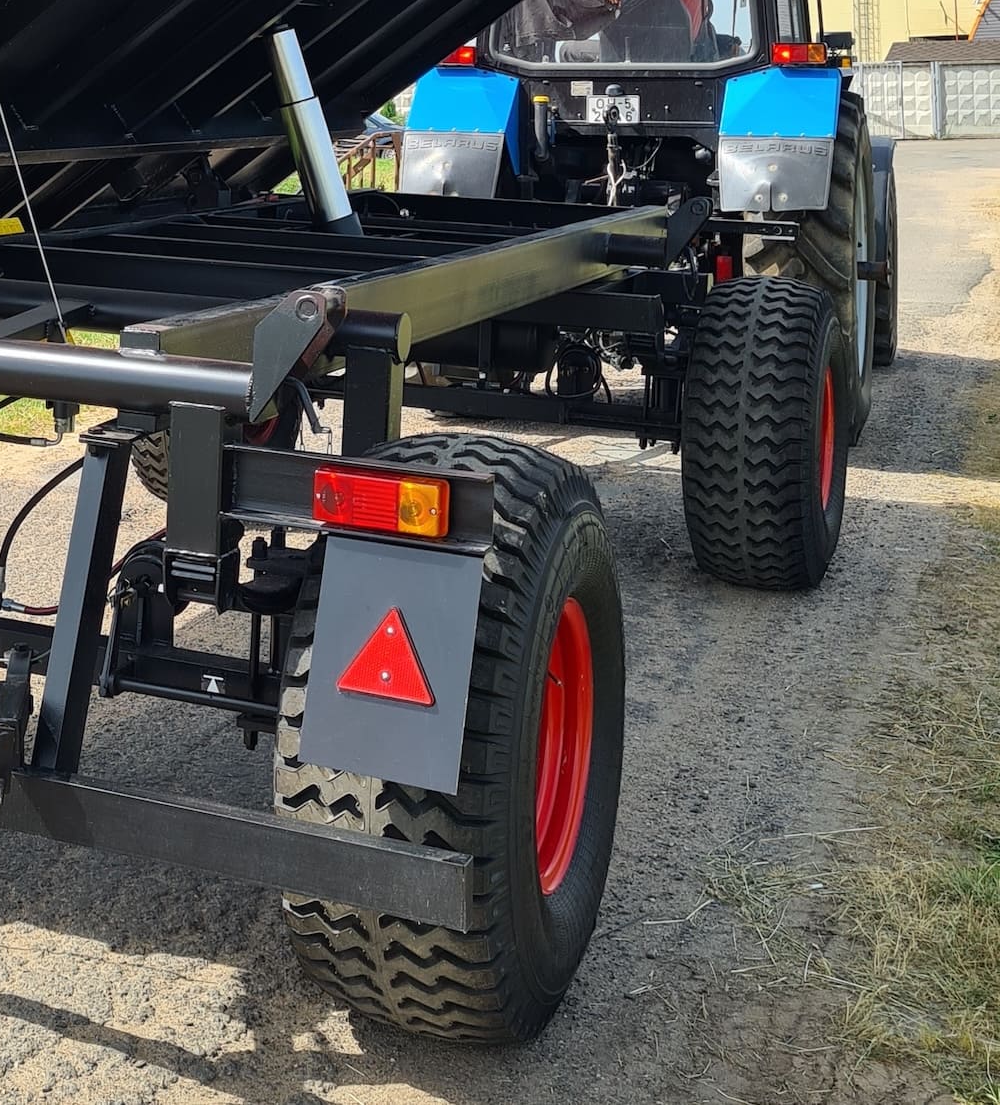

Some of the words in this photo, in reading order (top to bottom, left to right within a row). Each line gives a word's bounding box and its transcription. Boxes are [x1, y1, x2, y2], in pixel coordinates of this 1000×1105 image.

[594, 110, 633, 122] 26
[406, 138, 499, 151] BELARUS
[725, 141, 829, 156] BELARUS
